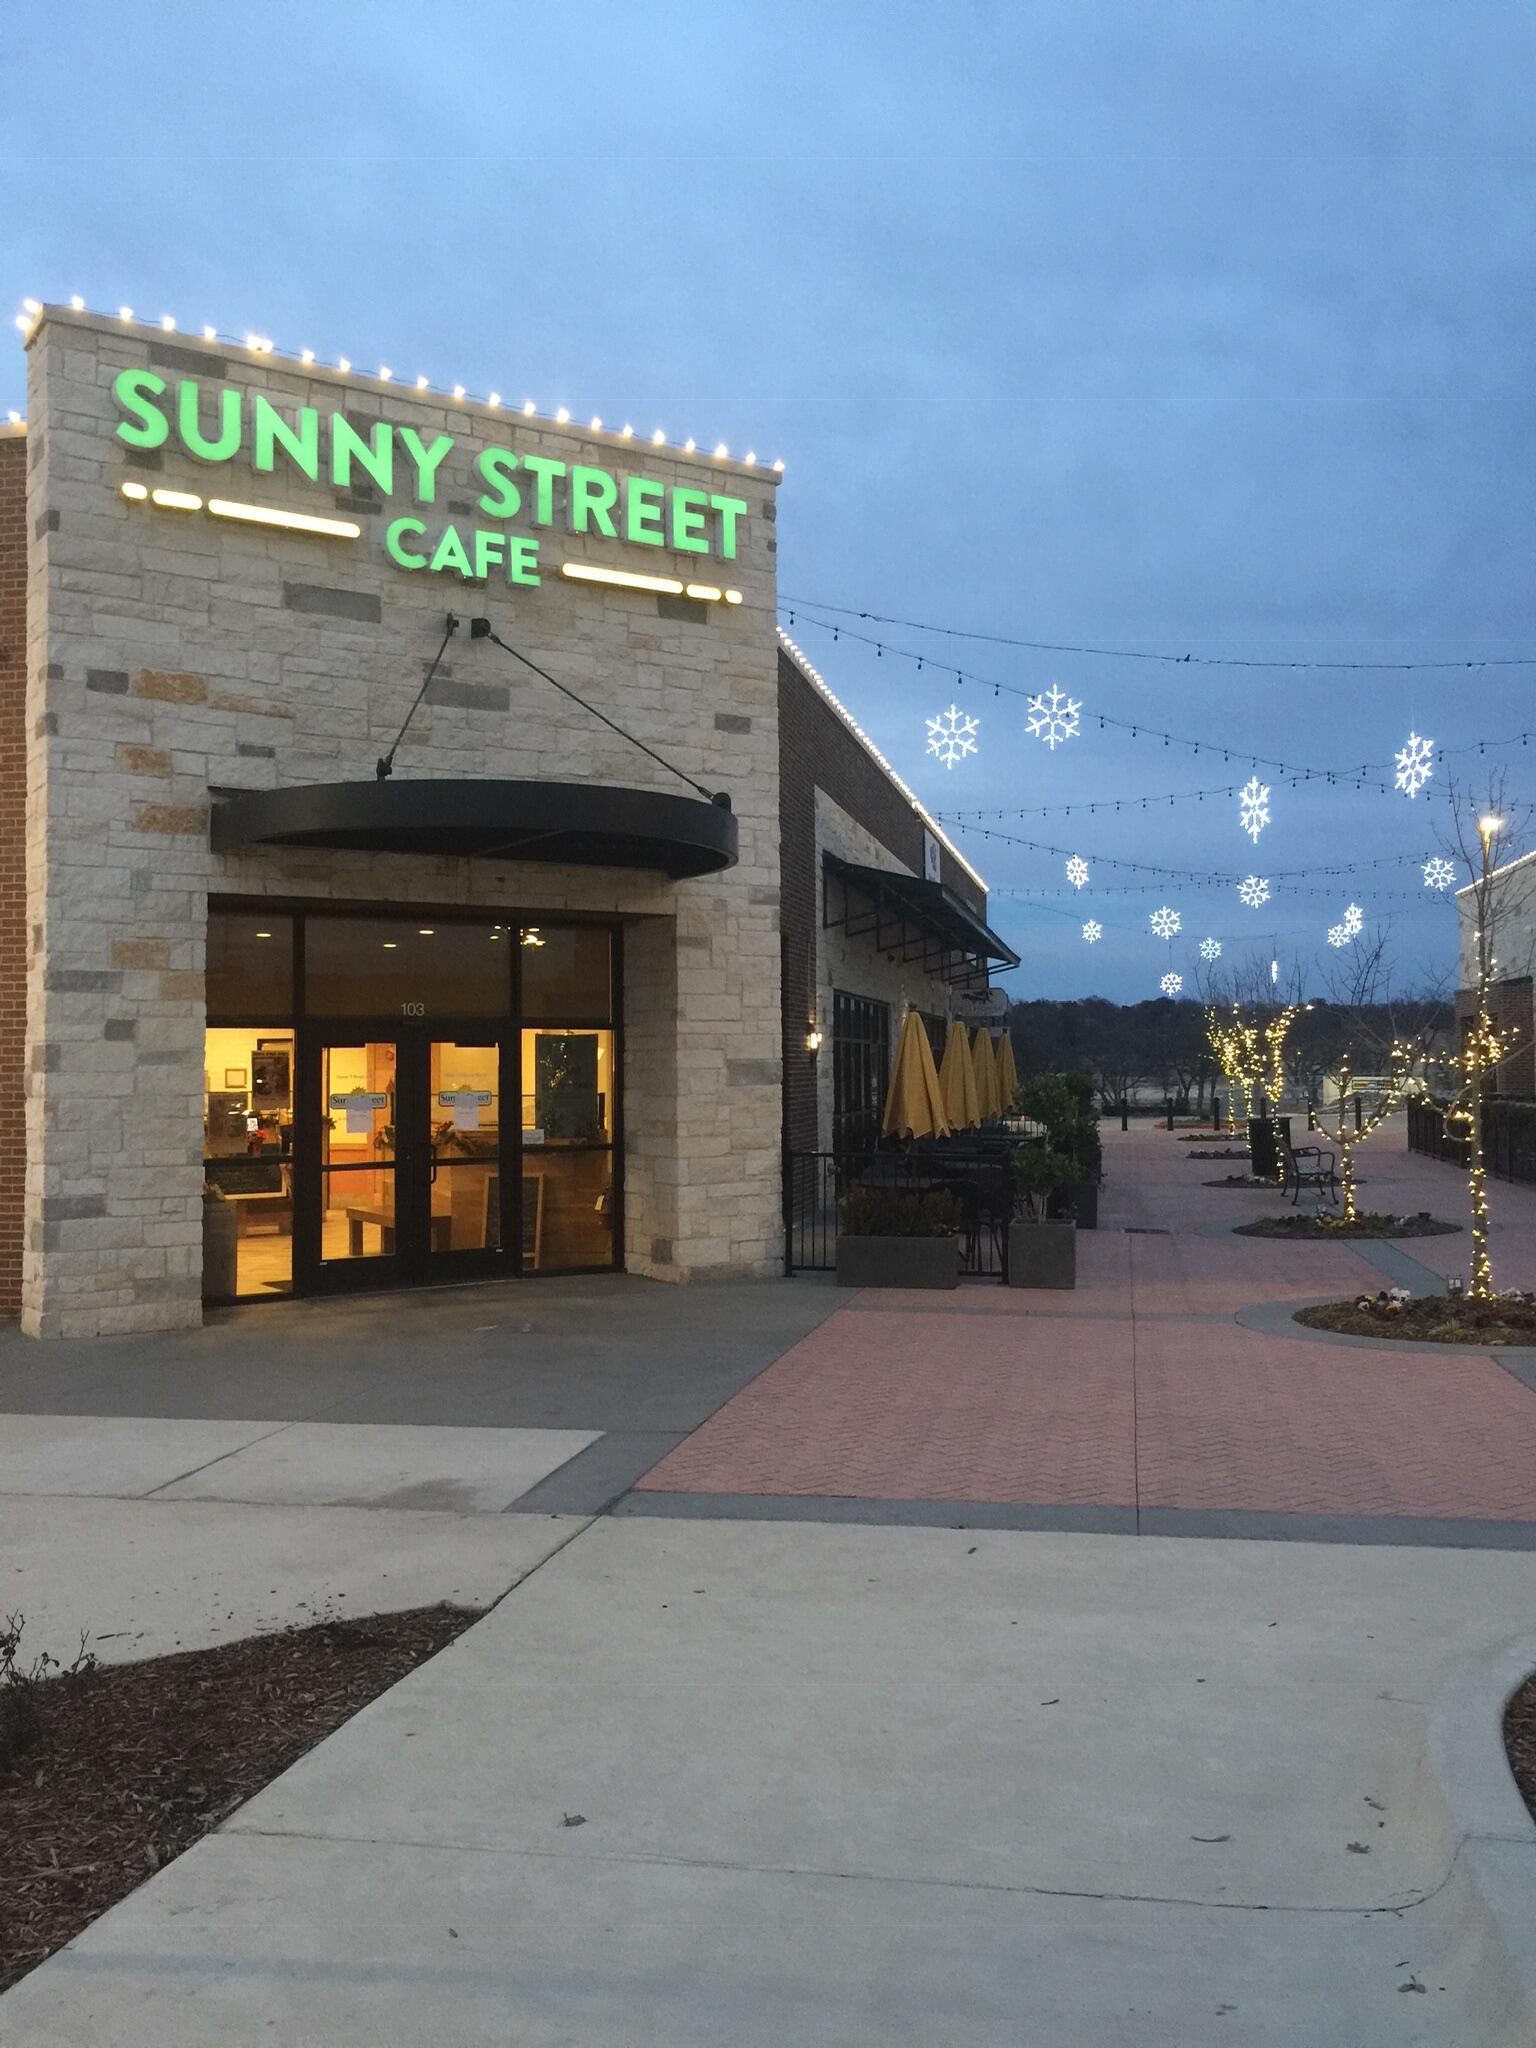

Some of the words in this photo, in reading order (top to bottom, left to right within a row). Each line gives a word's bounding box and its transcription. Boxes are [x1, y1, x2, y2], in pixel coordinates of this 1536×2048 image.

[113, 369, 455, 504] SUNNY
[477, 447, 748, 560] STREET
[386, 517, 542, 586] CAFE
[400, 1002, 425, 1016] 103
